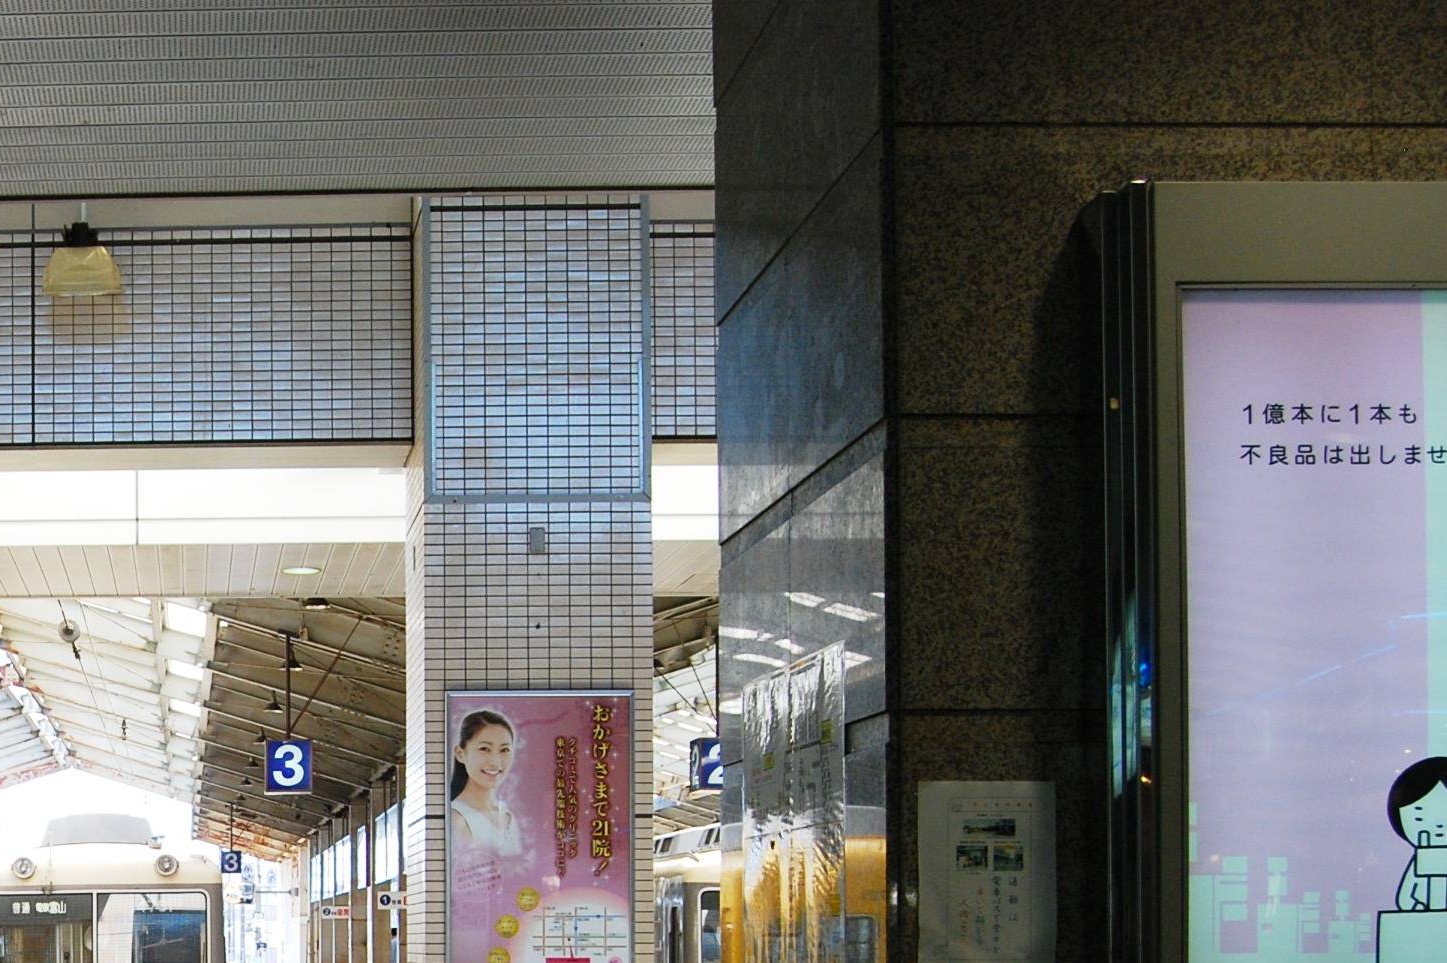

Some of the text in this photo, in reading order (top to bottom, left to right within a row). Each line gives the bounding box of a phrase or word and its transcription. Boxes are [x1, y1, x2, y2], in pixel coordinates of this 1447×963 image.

[1241, 403, 1418, 426] 1億本に1本も
[1239, 443, 1447, 467] 不良品は出しませ
[272, 744, 305, 787] 3
[222, 853, 239, 872] 3
